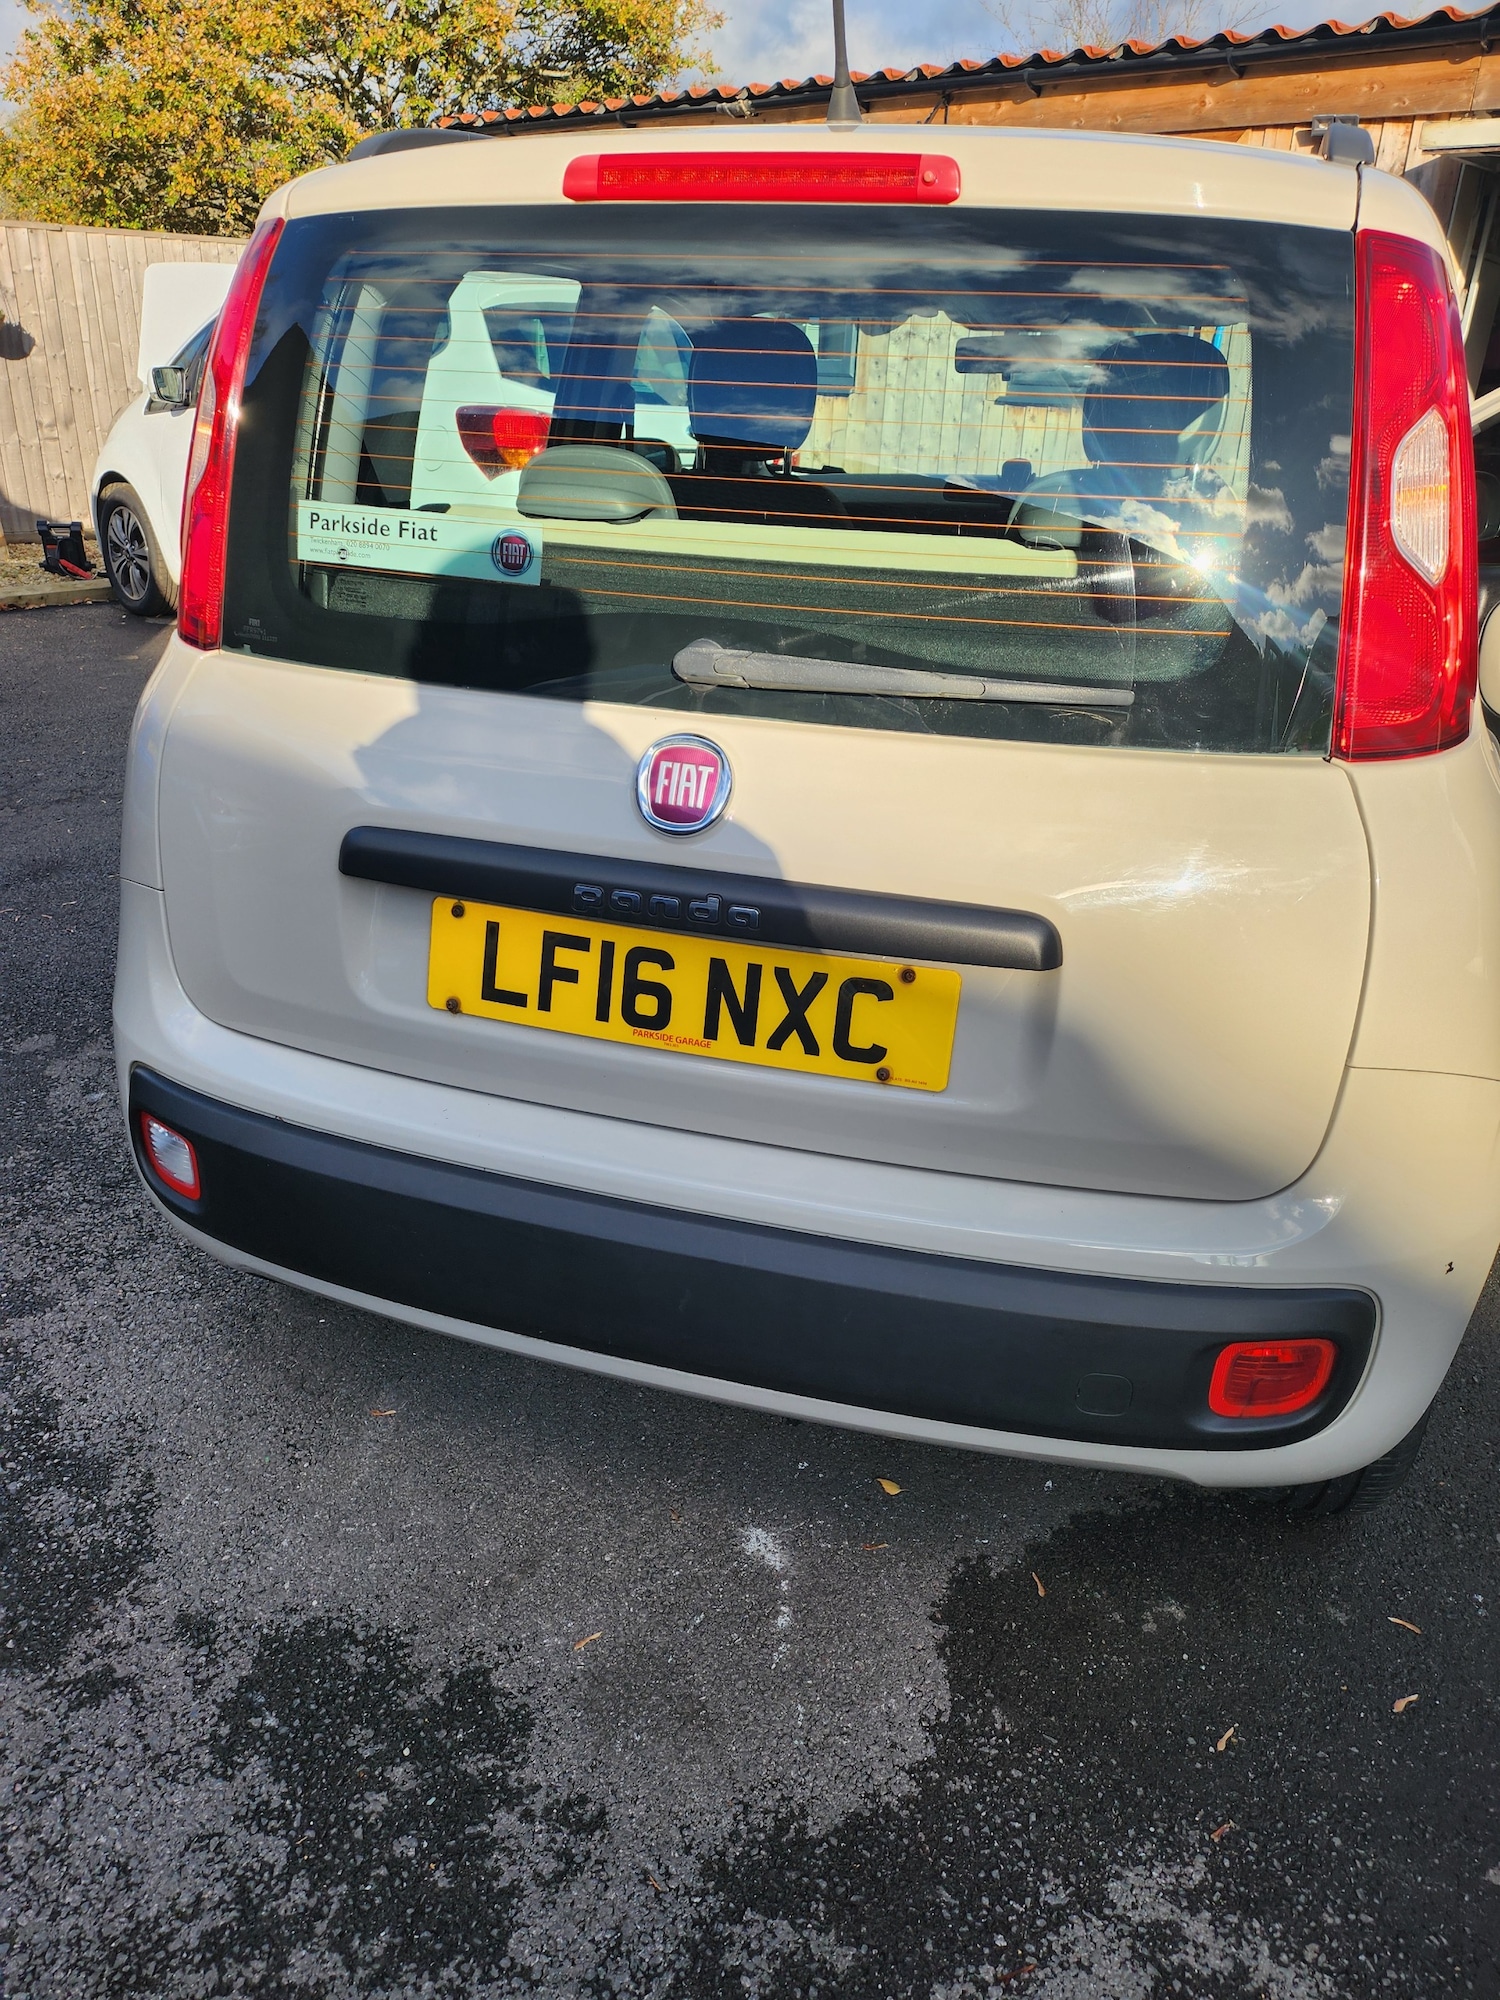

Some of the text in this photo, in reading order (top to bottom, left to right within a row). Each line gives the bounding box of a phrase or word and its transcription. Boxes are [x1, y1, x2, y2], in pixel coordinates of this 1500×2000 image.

[309, 512, 438, 542] Parkside Fiat
[502, 542, 526, 565] FIAT
[655, 760, 715, 810] FIAT
[573, 883, 761, 931] panda
[481, 920, 895, 1065] LF16 NXC
[632, 1028, 674, 1043] PARKSIDE
[675, 1036, 712, 1049] GARAGE
